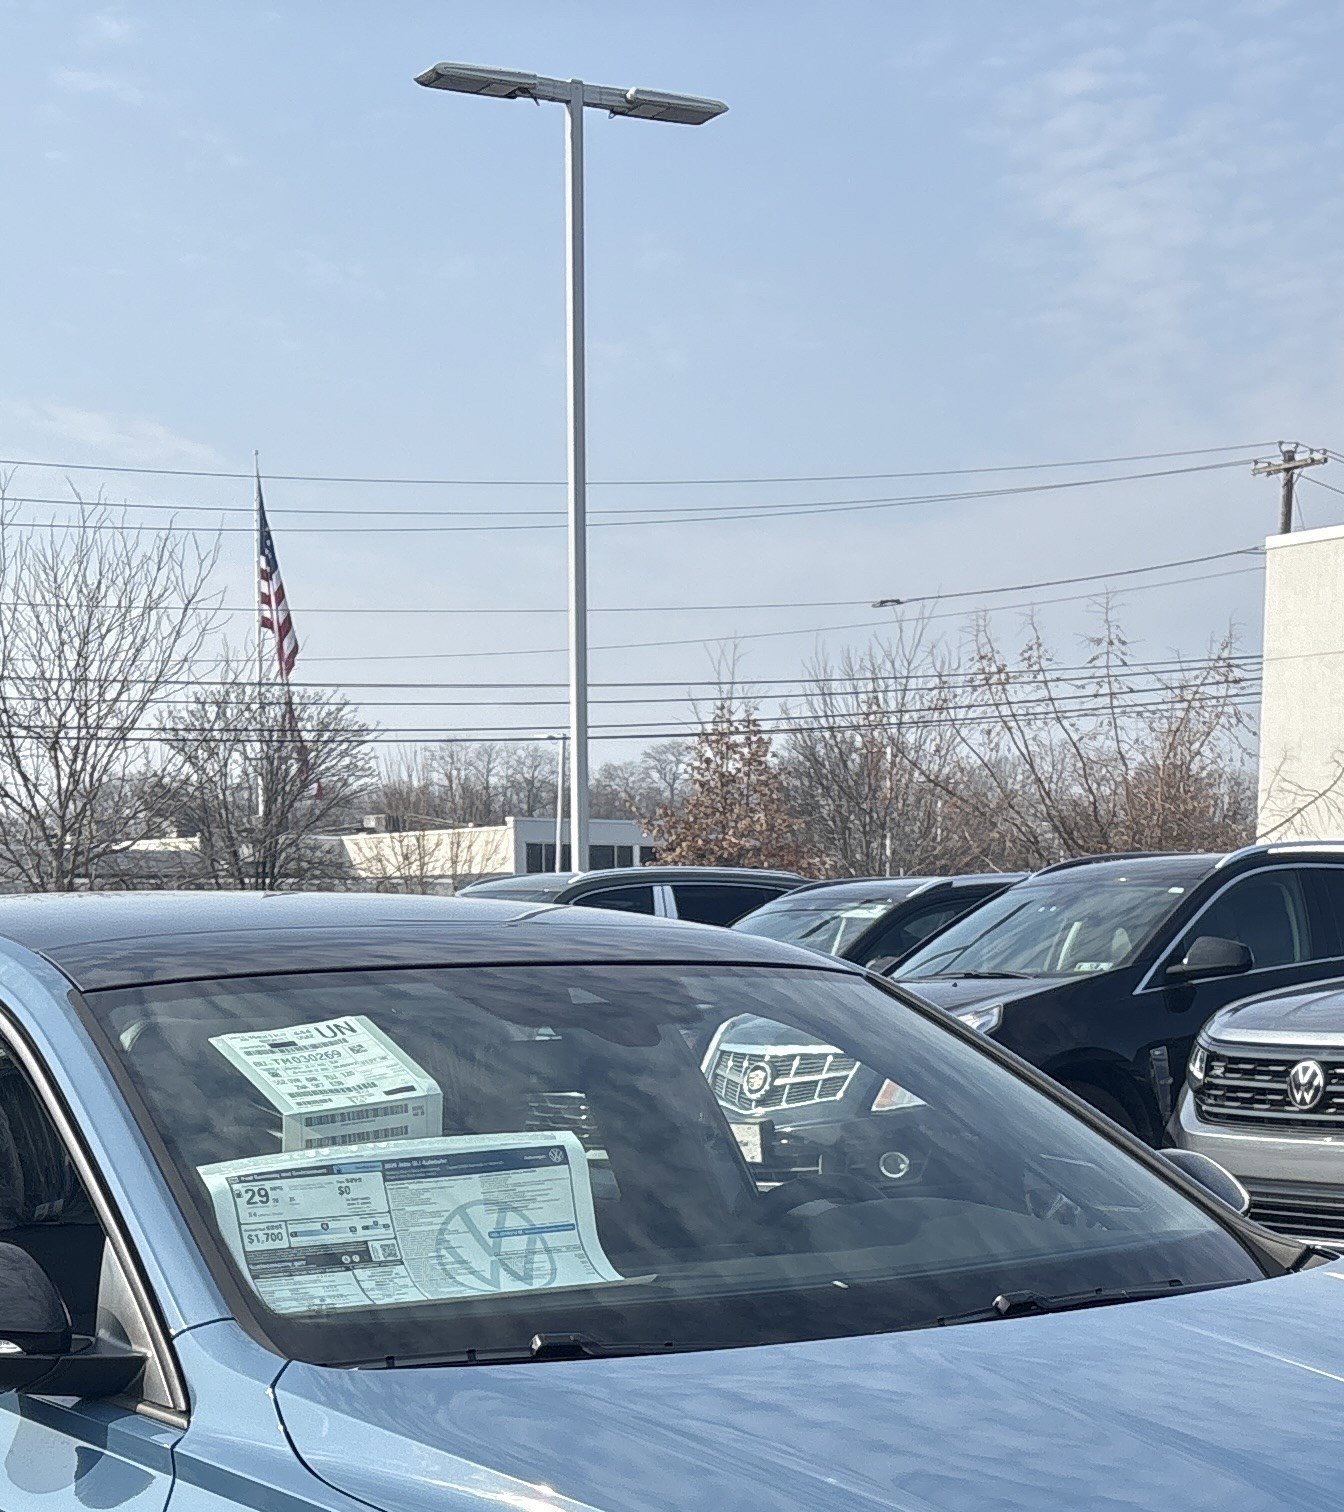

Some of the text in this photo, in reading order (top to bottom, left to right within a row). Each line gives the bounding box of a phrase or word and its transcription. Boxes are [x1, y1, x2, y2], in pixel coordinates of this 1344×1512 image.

[313, 1020, 358, 1040] UN
[1287, 1058, 1325, 1110] VW
[244, 1187, 270, 1206] 29
[337, 1185, 351, 1197] $0
[246, 1231, 284, 1246] $1,700
